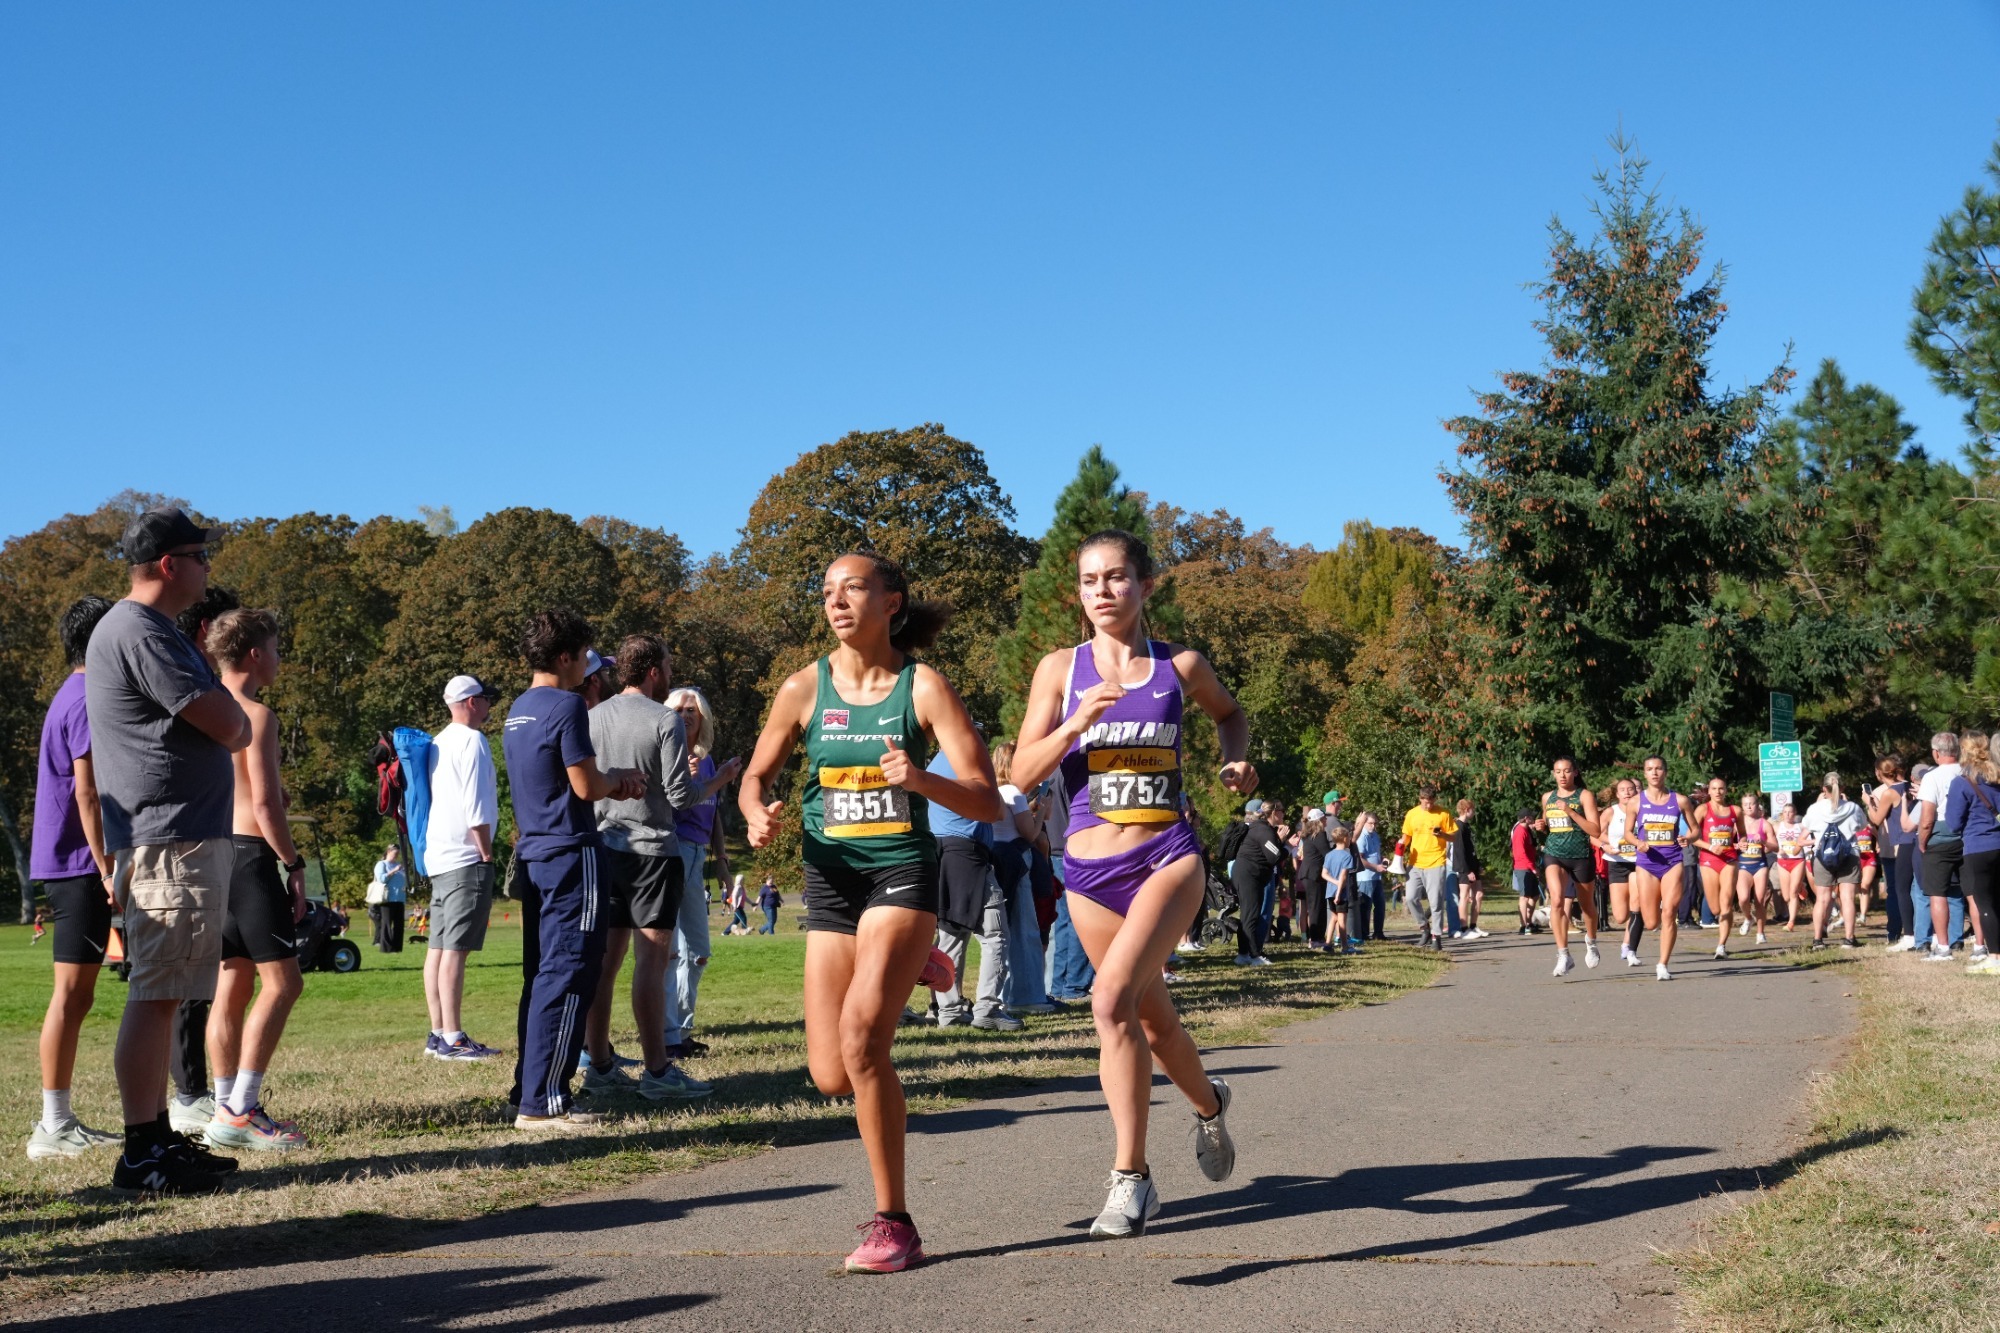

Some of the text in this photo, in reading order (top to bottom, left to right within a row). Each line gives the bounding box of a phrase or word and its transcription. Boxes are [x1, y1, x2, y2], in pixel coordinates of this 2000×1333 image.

[1080, 721, 1178, 754] PORTLAND
[832, 789, 898, 821] 5551
[1101, 774, 1171, 806] 5752
[1647, 830, 1672, 841] 5750
